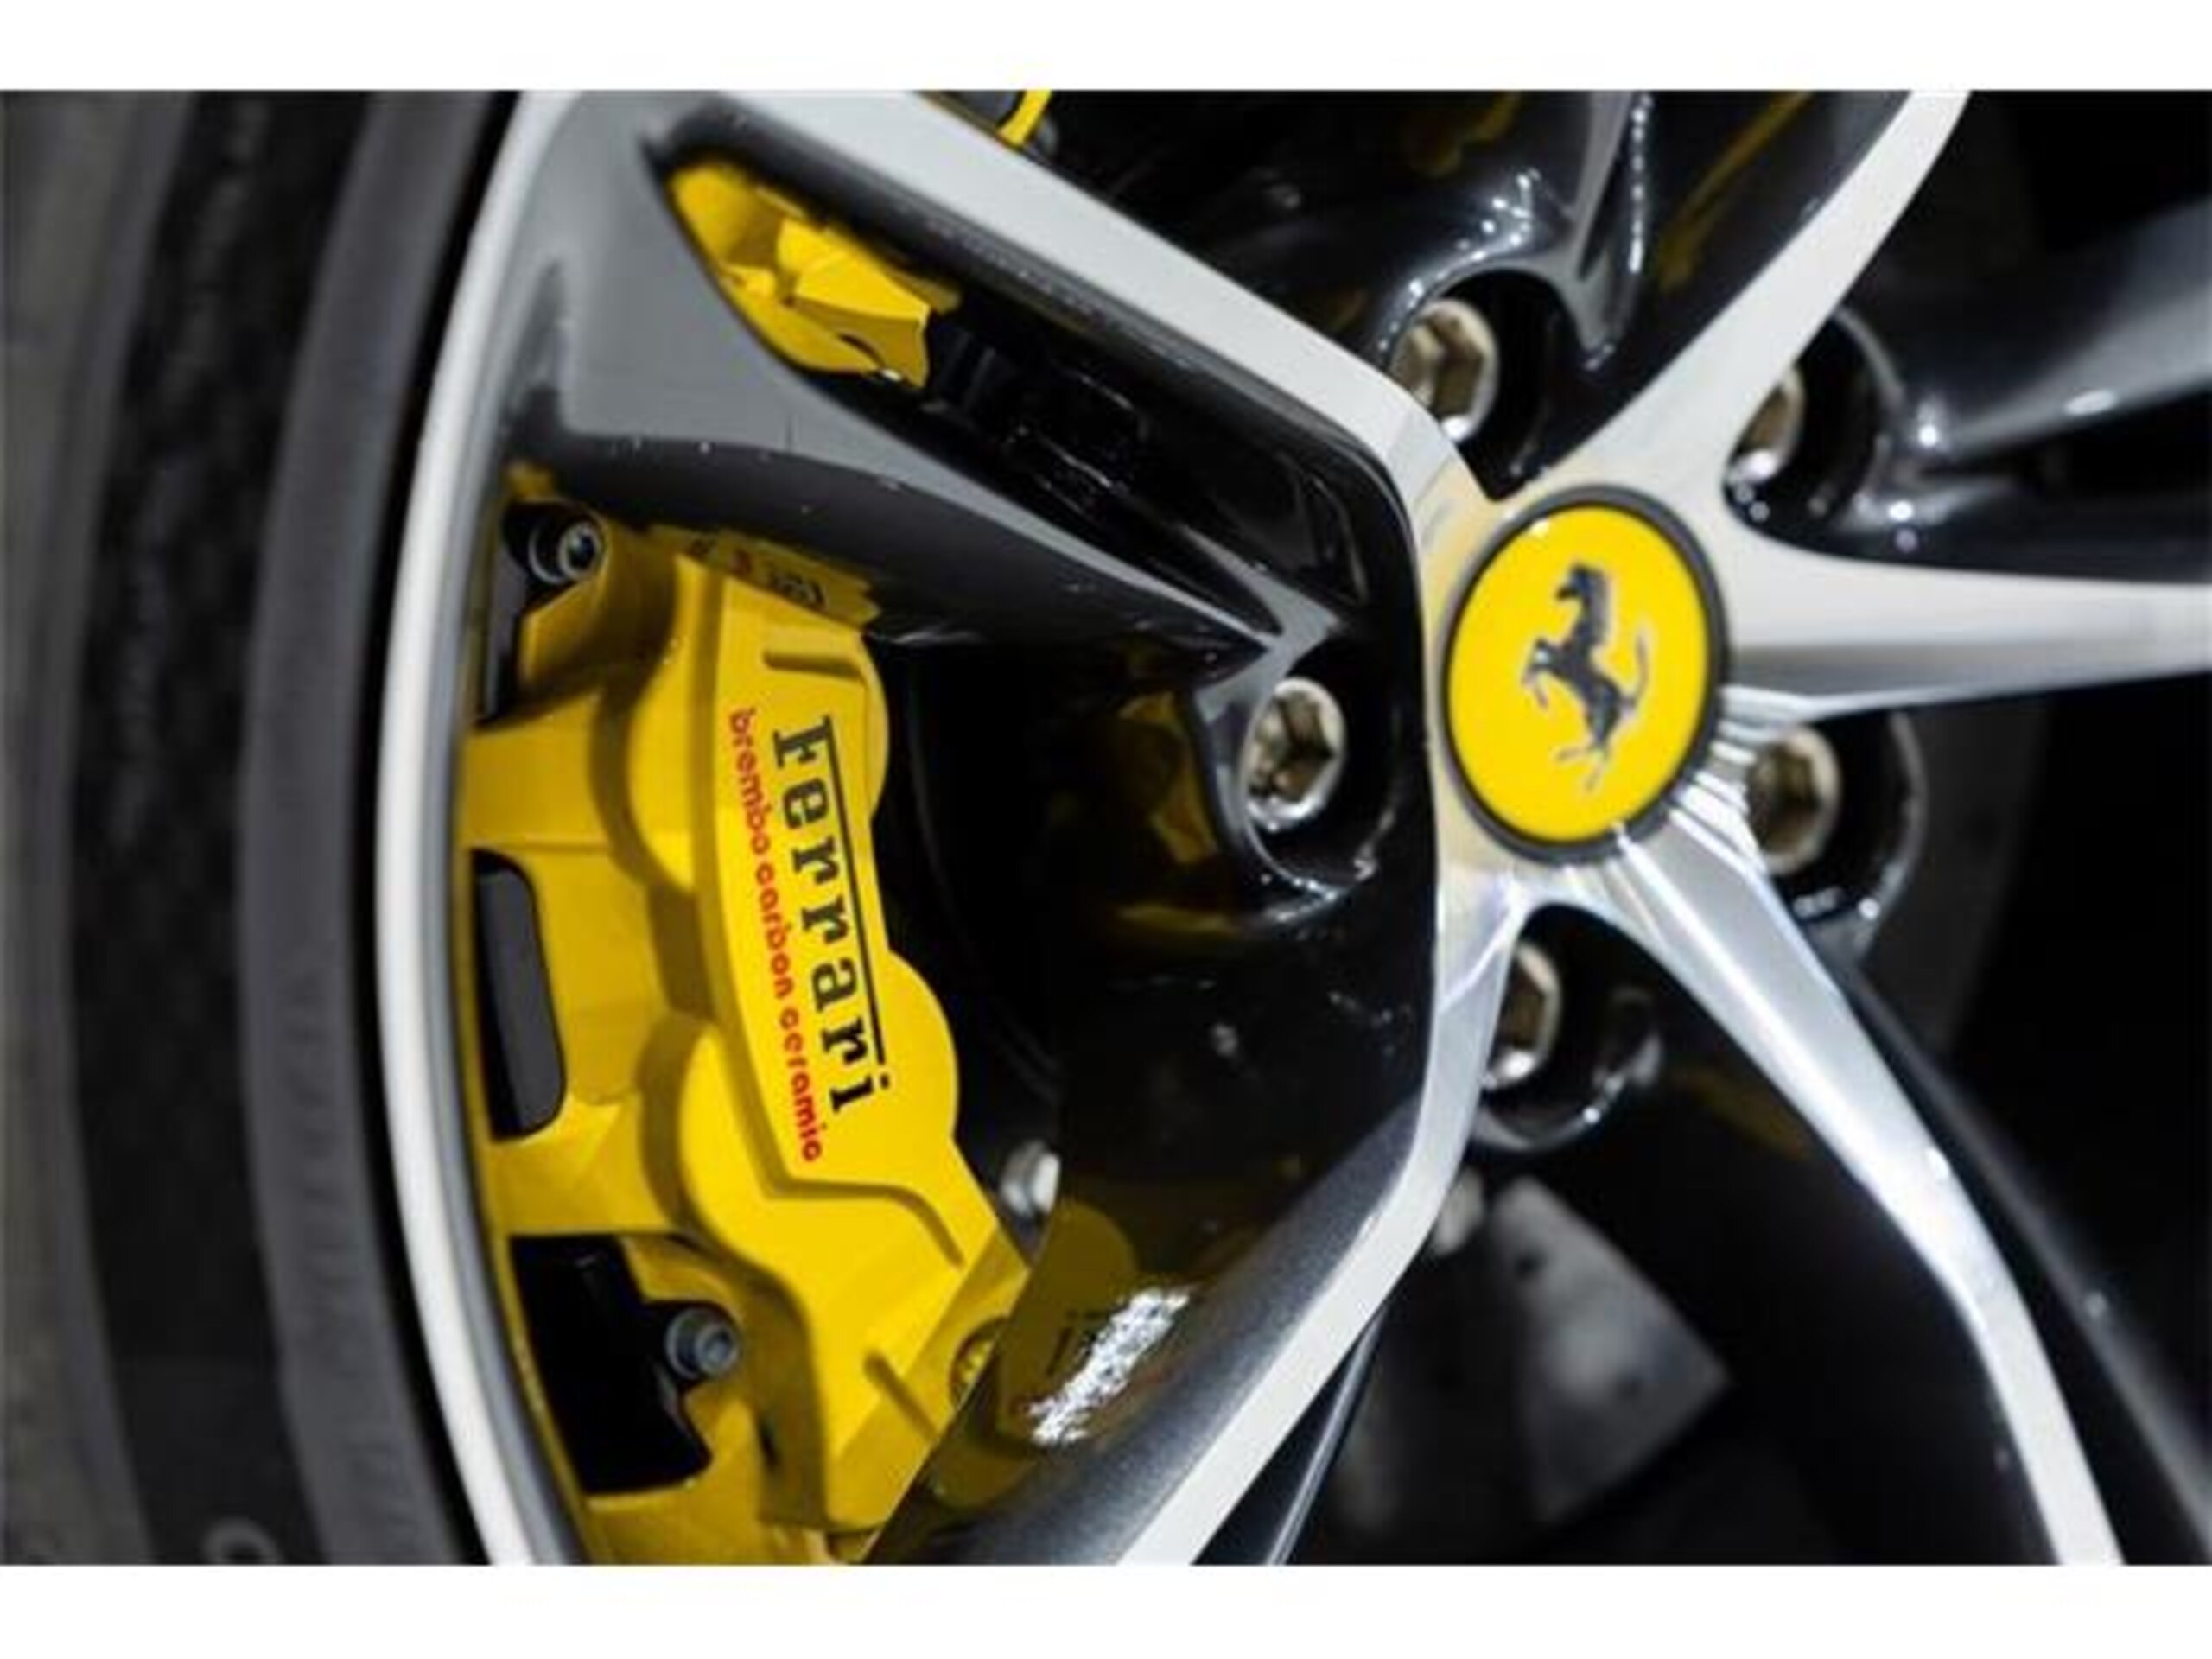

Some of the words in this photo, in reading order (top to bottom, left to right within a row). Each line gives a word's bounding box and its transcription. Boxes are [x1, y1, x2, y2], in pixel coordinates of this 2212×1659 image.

[729, 708, 771, 855] brembo
[754, 862, 795, 999] carbon
[779, 1007, 827, 1162] ceramic
[772, 715, 890, 1113] Ferrari
